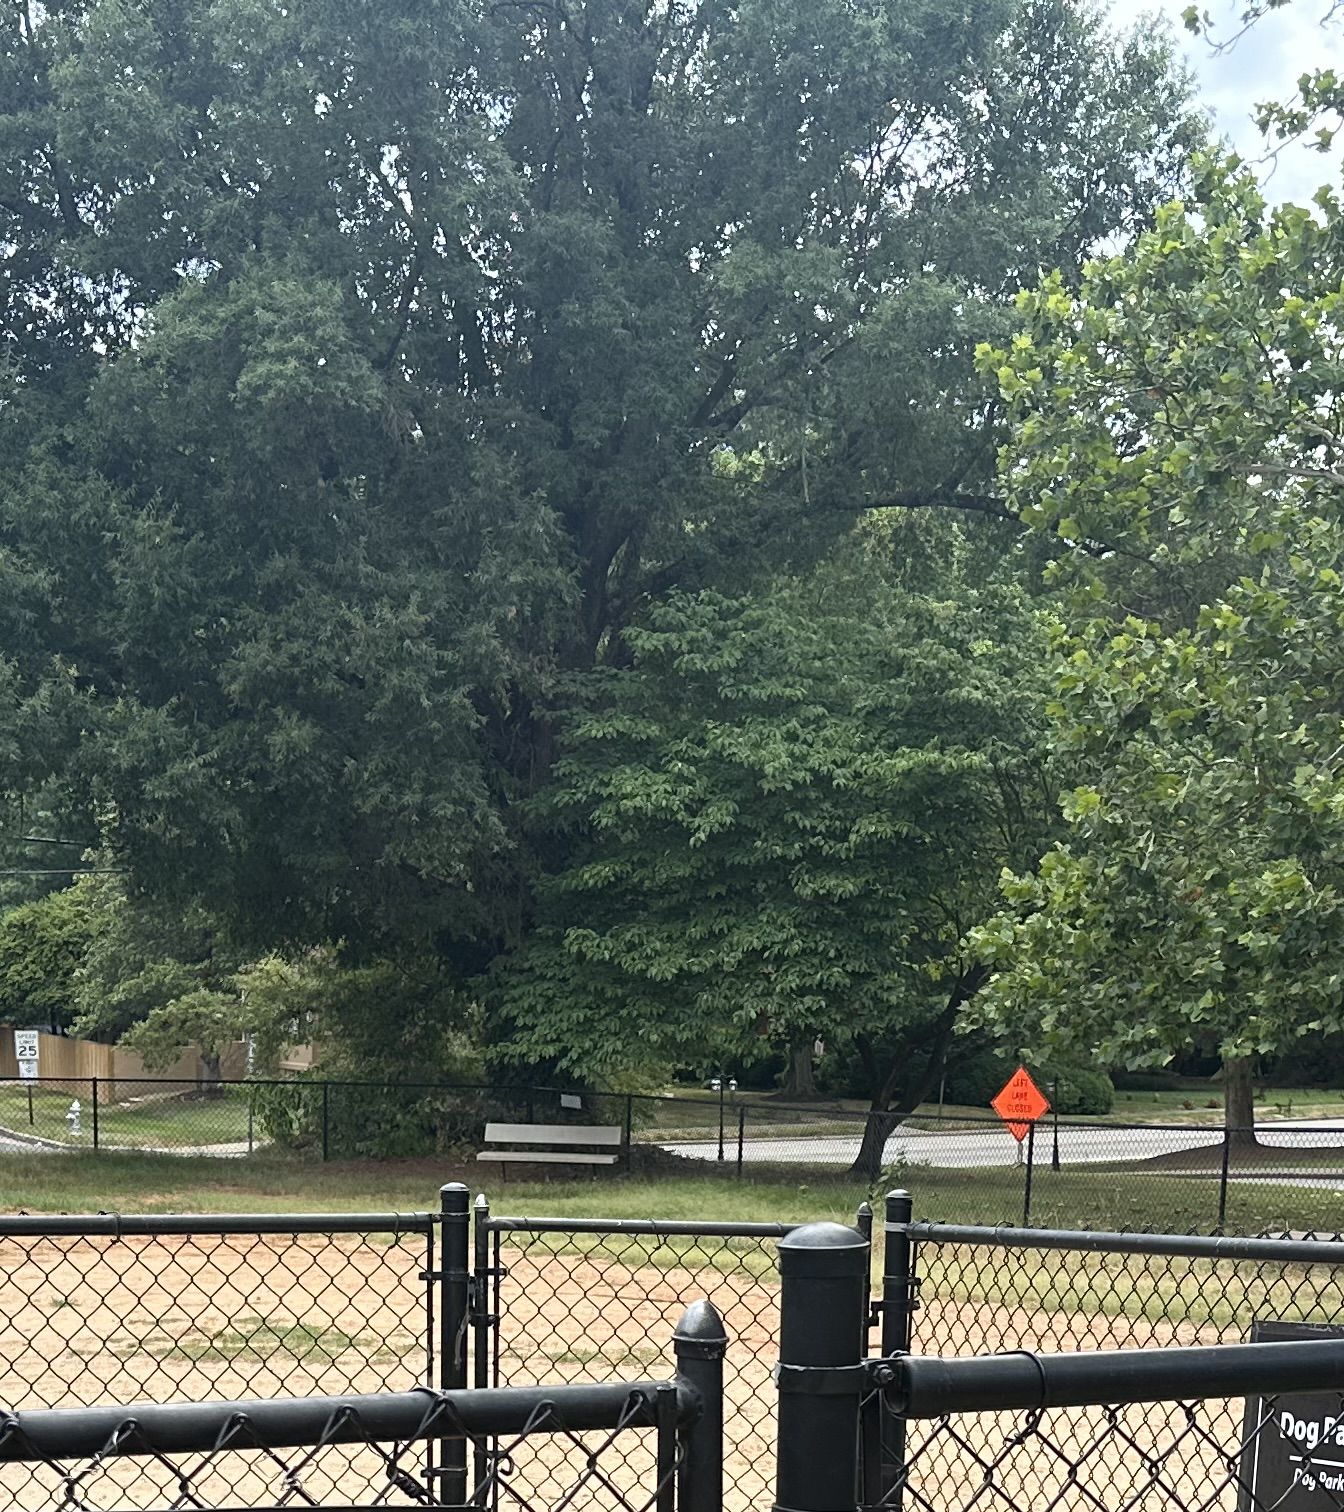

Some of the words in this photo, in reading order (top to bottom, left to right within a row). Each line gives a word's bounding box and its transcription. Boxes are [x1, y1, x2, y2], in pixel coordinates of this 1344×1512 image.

[19, 1046, 37, 1056] 25
[1280, 1411, 1320, 1450] Dog
[1293, 1468, 1316, 1491] Dog
[1318, 1471, 1344, 1492] Park
